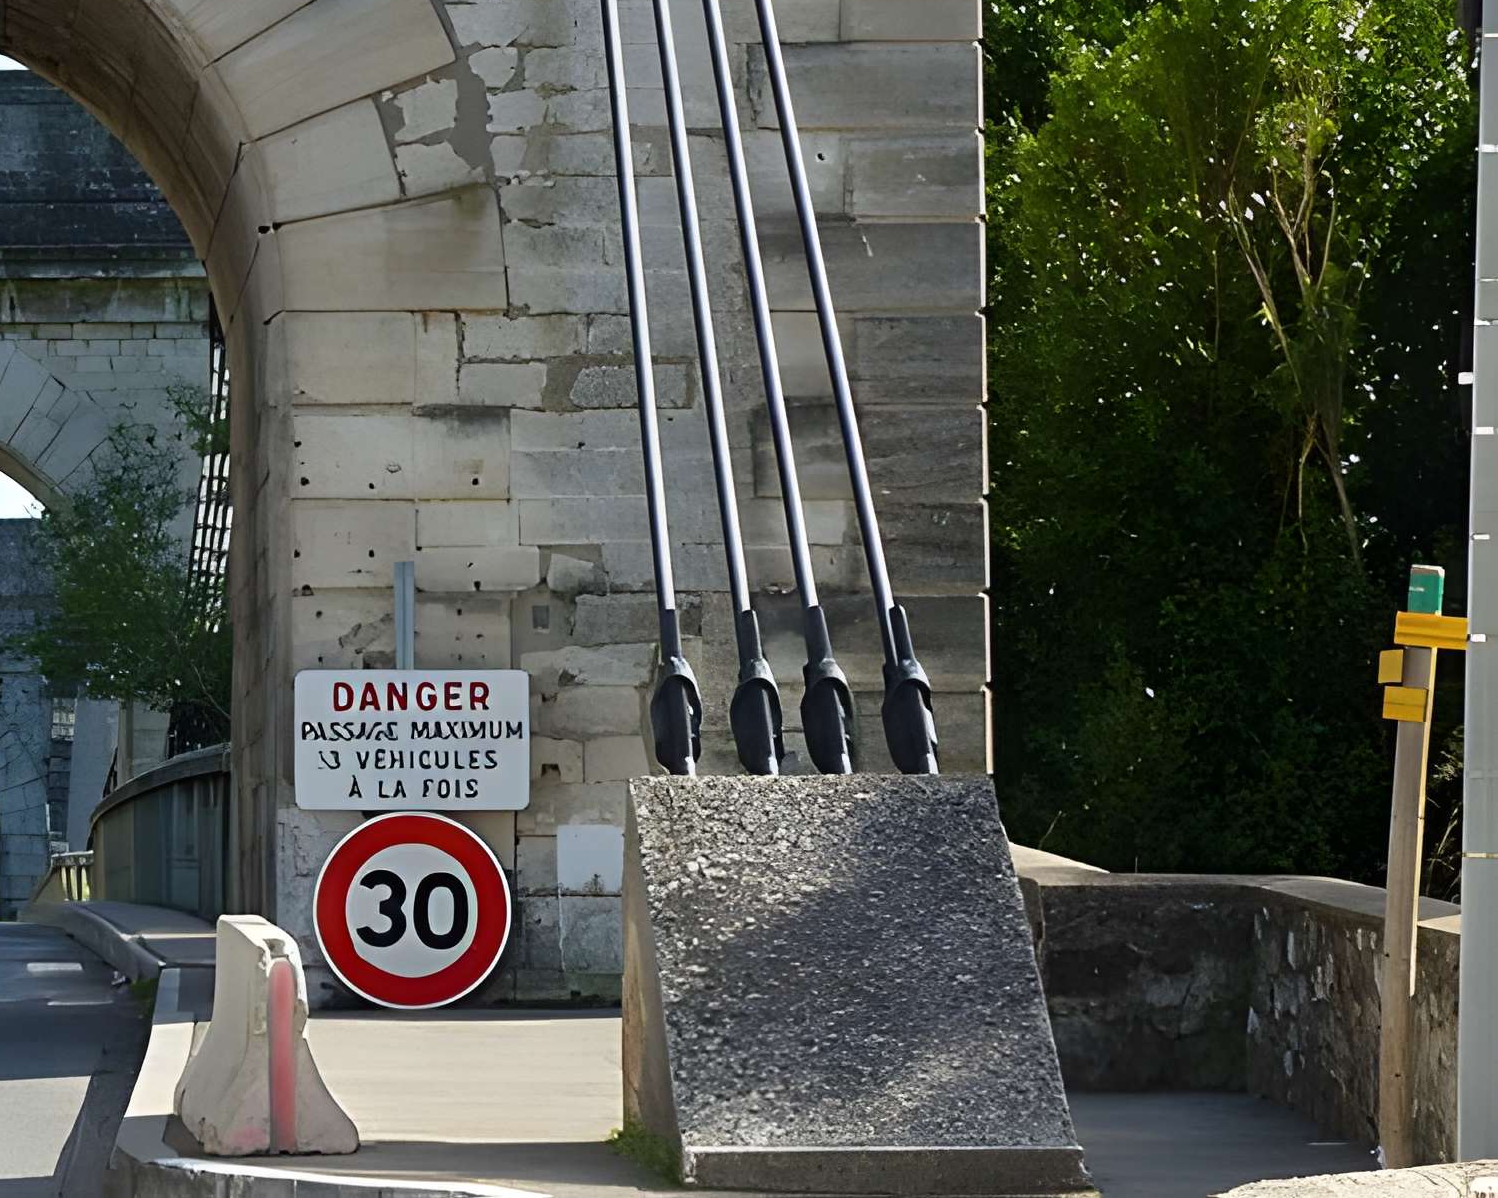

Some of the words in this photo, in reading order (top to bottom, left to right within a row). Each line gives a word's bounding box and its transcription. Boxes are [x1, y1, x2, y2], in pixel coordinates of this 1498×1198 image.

[332, 681, 490, 712] DANGER
[410, 721, 523, 740] MAXIMUM
[378, 780, 407, 799] LA
[422, 778, 479, 799] FOIS
[355, 868, 469, 950] 30
